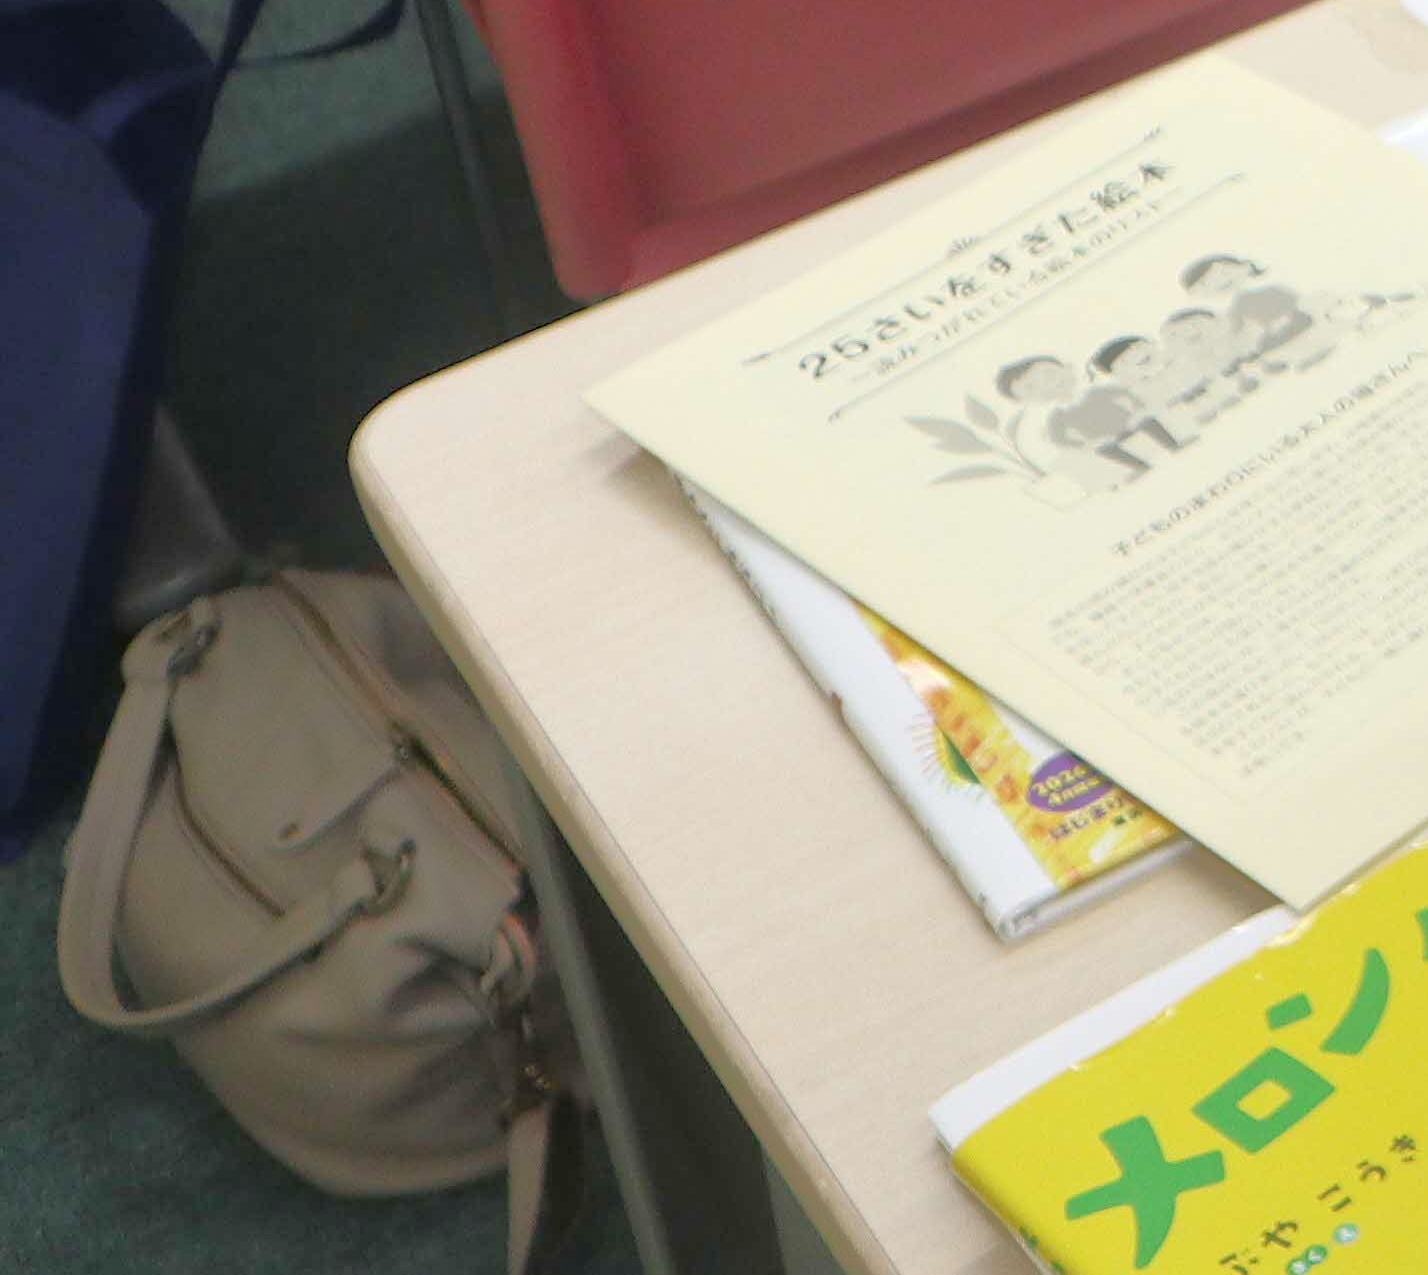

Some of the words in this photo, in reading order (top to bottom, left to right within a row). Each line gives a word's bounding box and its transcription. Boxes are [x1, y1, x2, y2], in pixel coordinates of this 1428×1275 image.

[798, 160, 1174, 381] 25さいをすぎた絵本
